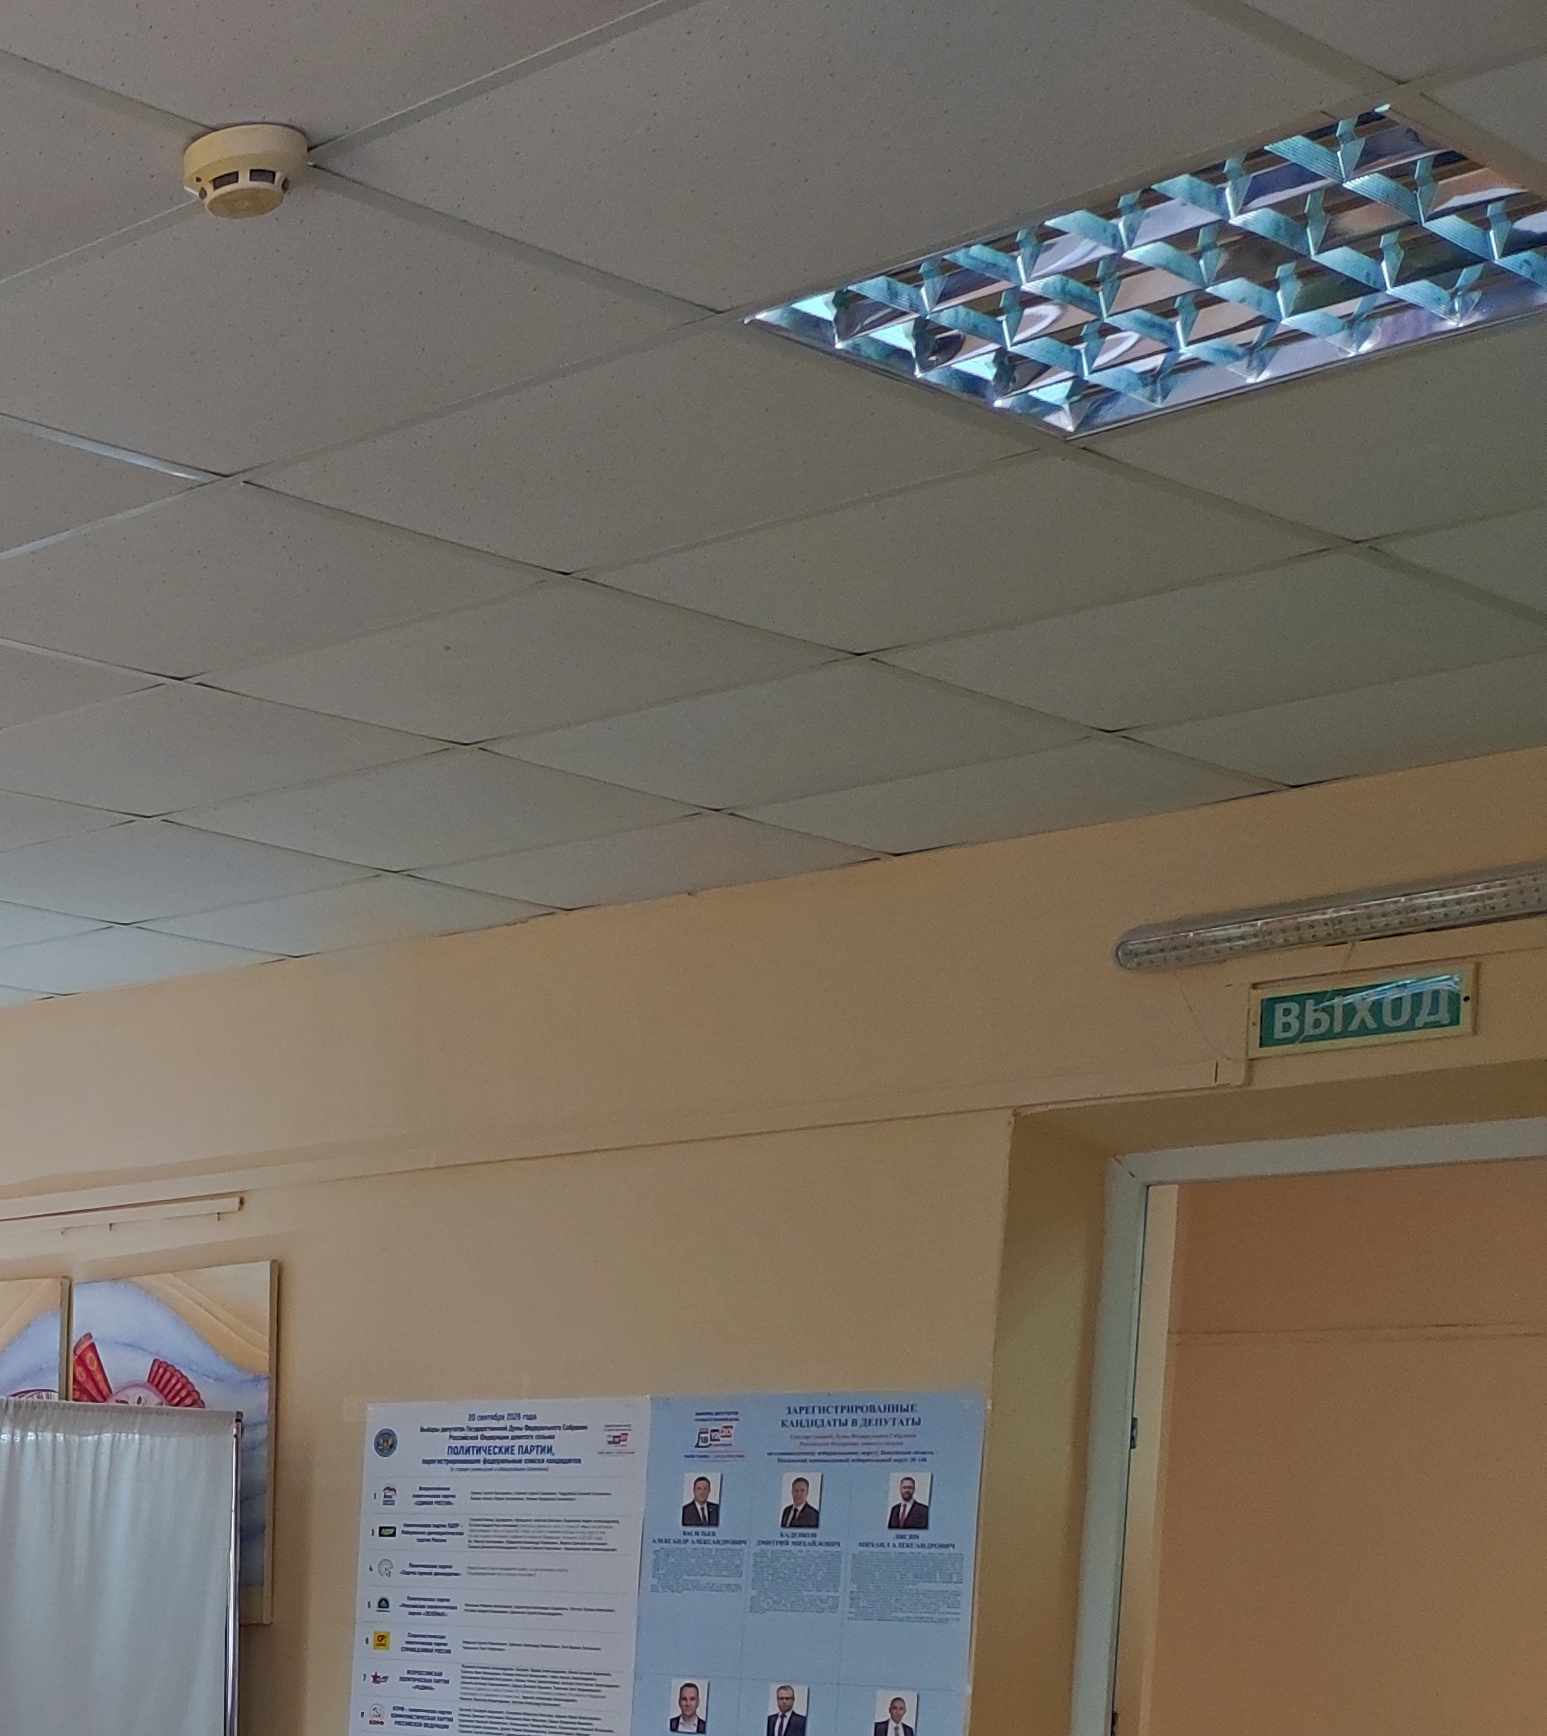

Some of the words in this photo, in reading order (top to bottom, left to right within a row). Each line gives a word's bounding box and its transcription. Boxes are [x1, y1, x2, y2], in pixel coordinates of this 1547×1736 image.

[1273, 986, 1451, 1040] ВЫХОД
[786, 1404, 917, 1415] ЗАРЕГИСТРИРОВАННЫЕ
[781, 1417, 848, 1428] КАНДИДАТЫ
[851, 1417, 858, 1427] В
[859, 1417, 921, 1428] ДЕПУТАТЫ
[447, 1445, 516, 1456] ПОЛИТИЧЕСКИЕ
[517, 1445, 555, 1456] ПАРТИИ,
